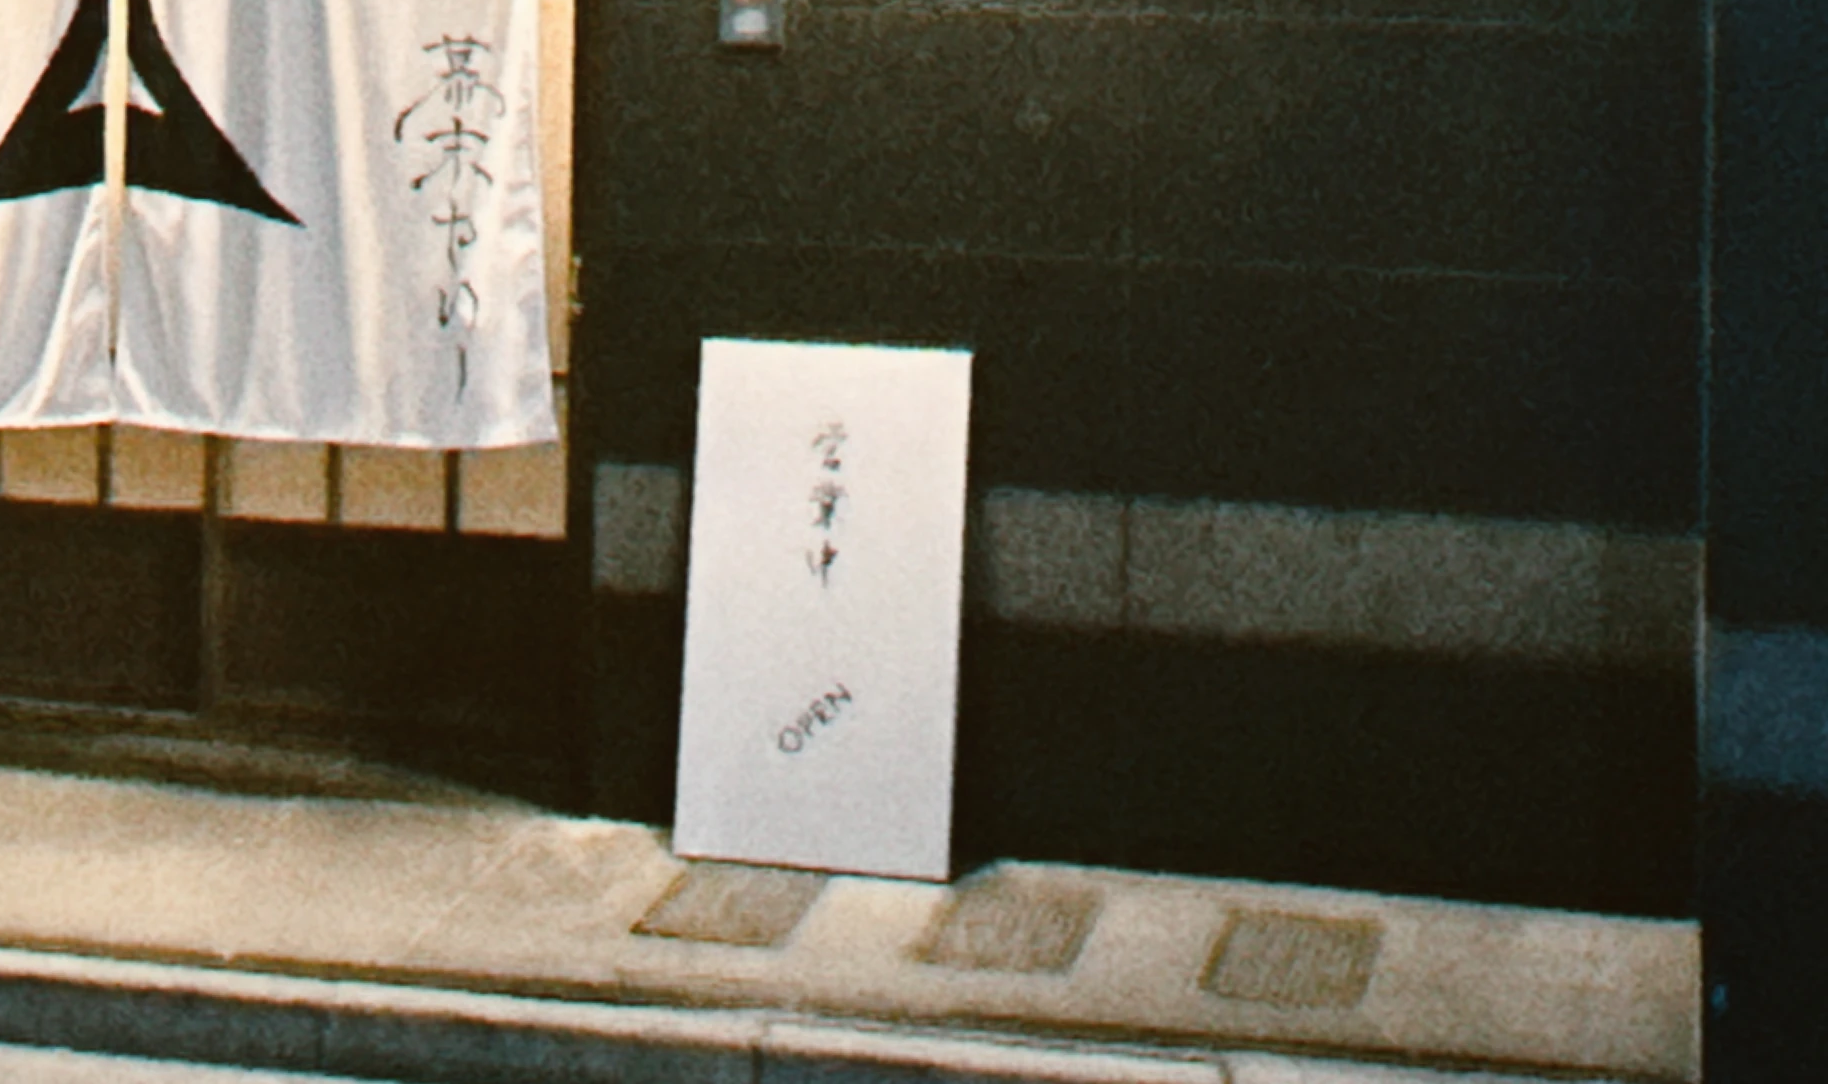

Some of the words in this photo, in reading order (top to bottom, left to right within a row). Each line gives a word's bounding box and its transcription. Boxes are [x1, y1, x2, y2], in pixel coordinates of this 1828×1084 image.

[806, 422, 849, 589] 営業中
[778, 681, 852, 753] OPEN
